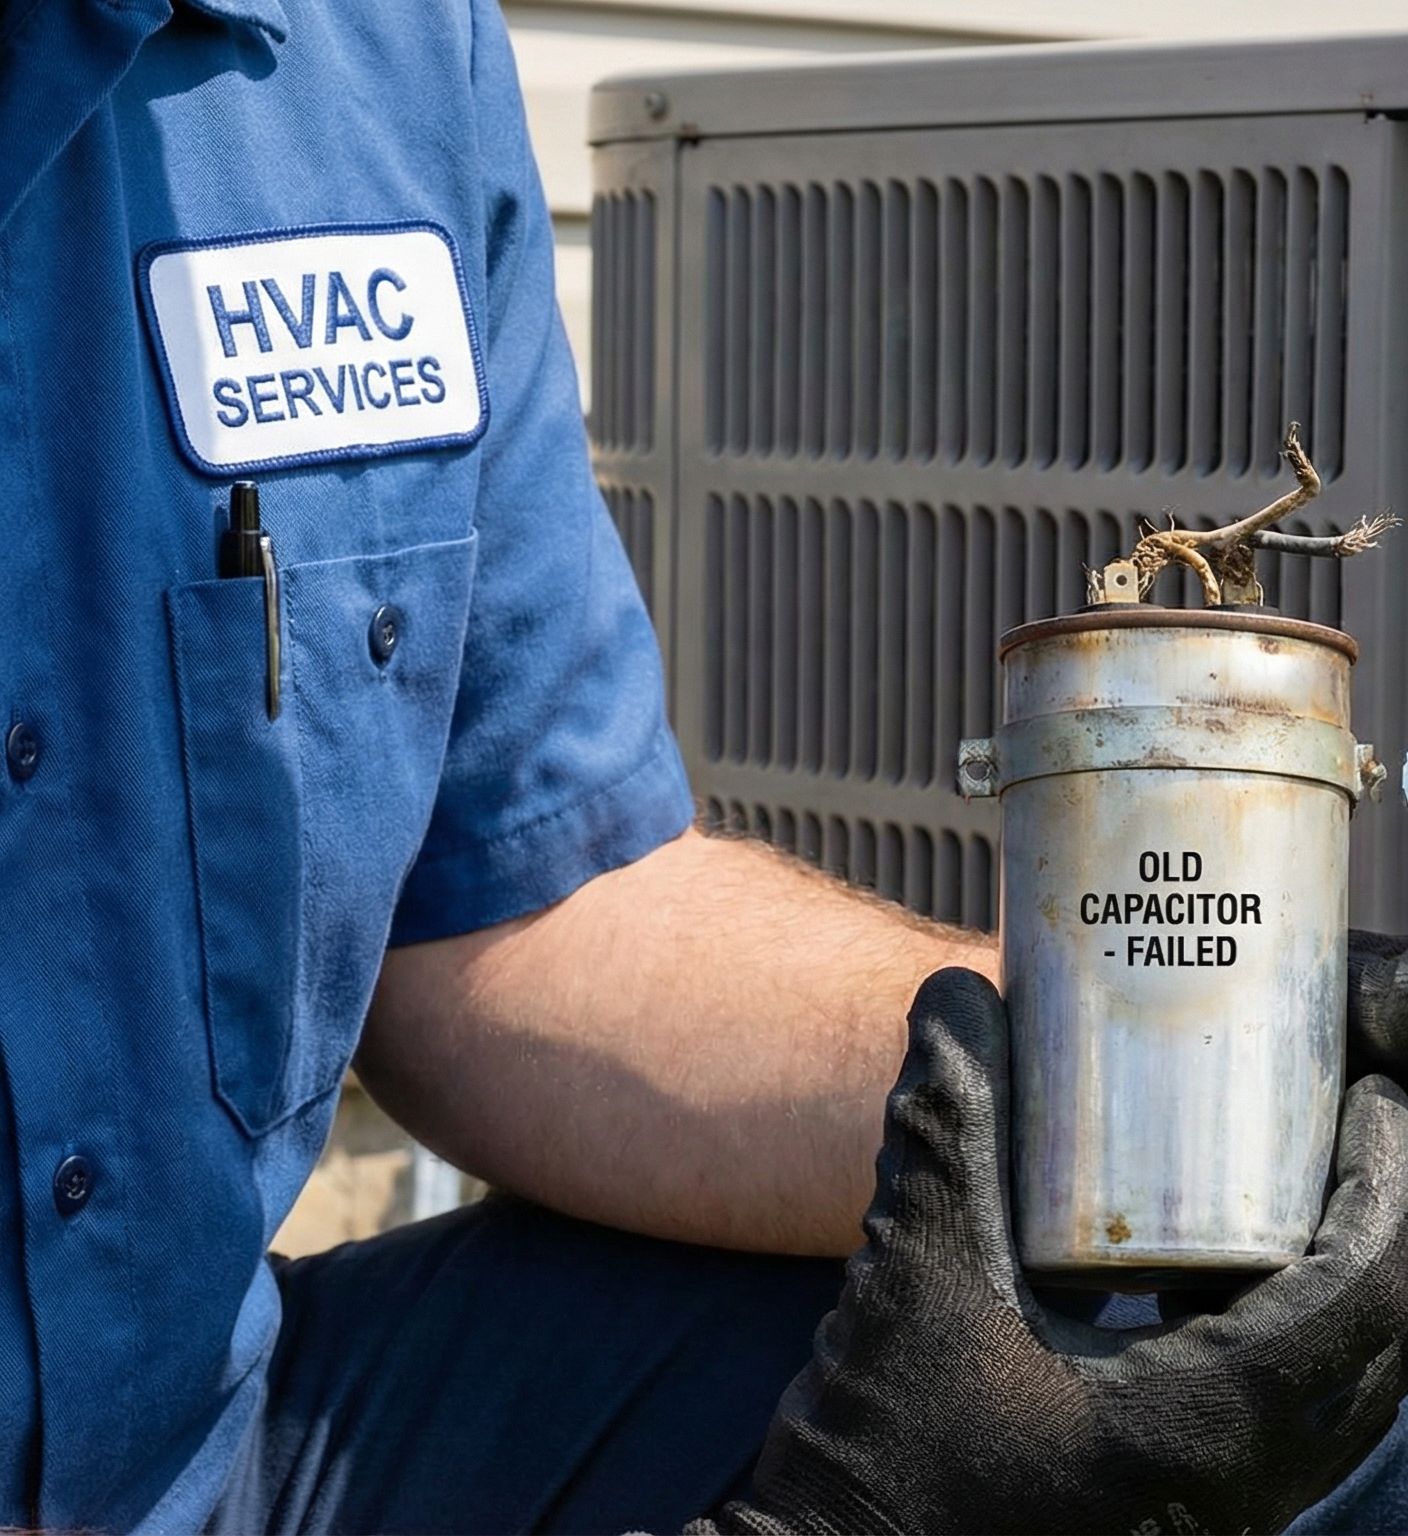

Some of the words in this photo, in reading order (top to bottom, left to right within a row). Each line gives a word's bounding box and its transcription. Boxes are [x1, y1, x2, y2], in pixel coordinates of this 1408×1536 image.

[206, 267, 415, 358] HVAC
[212, 355, 447, 428] SERVICES
[1138, 850, 1203, 883] OLD
[1080, 892, 1262, 925] CAPACITOR
[1127, 935, 1238, 967] FAILED
